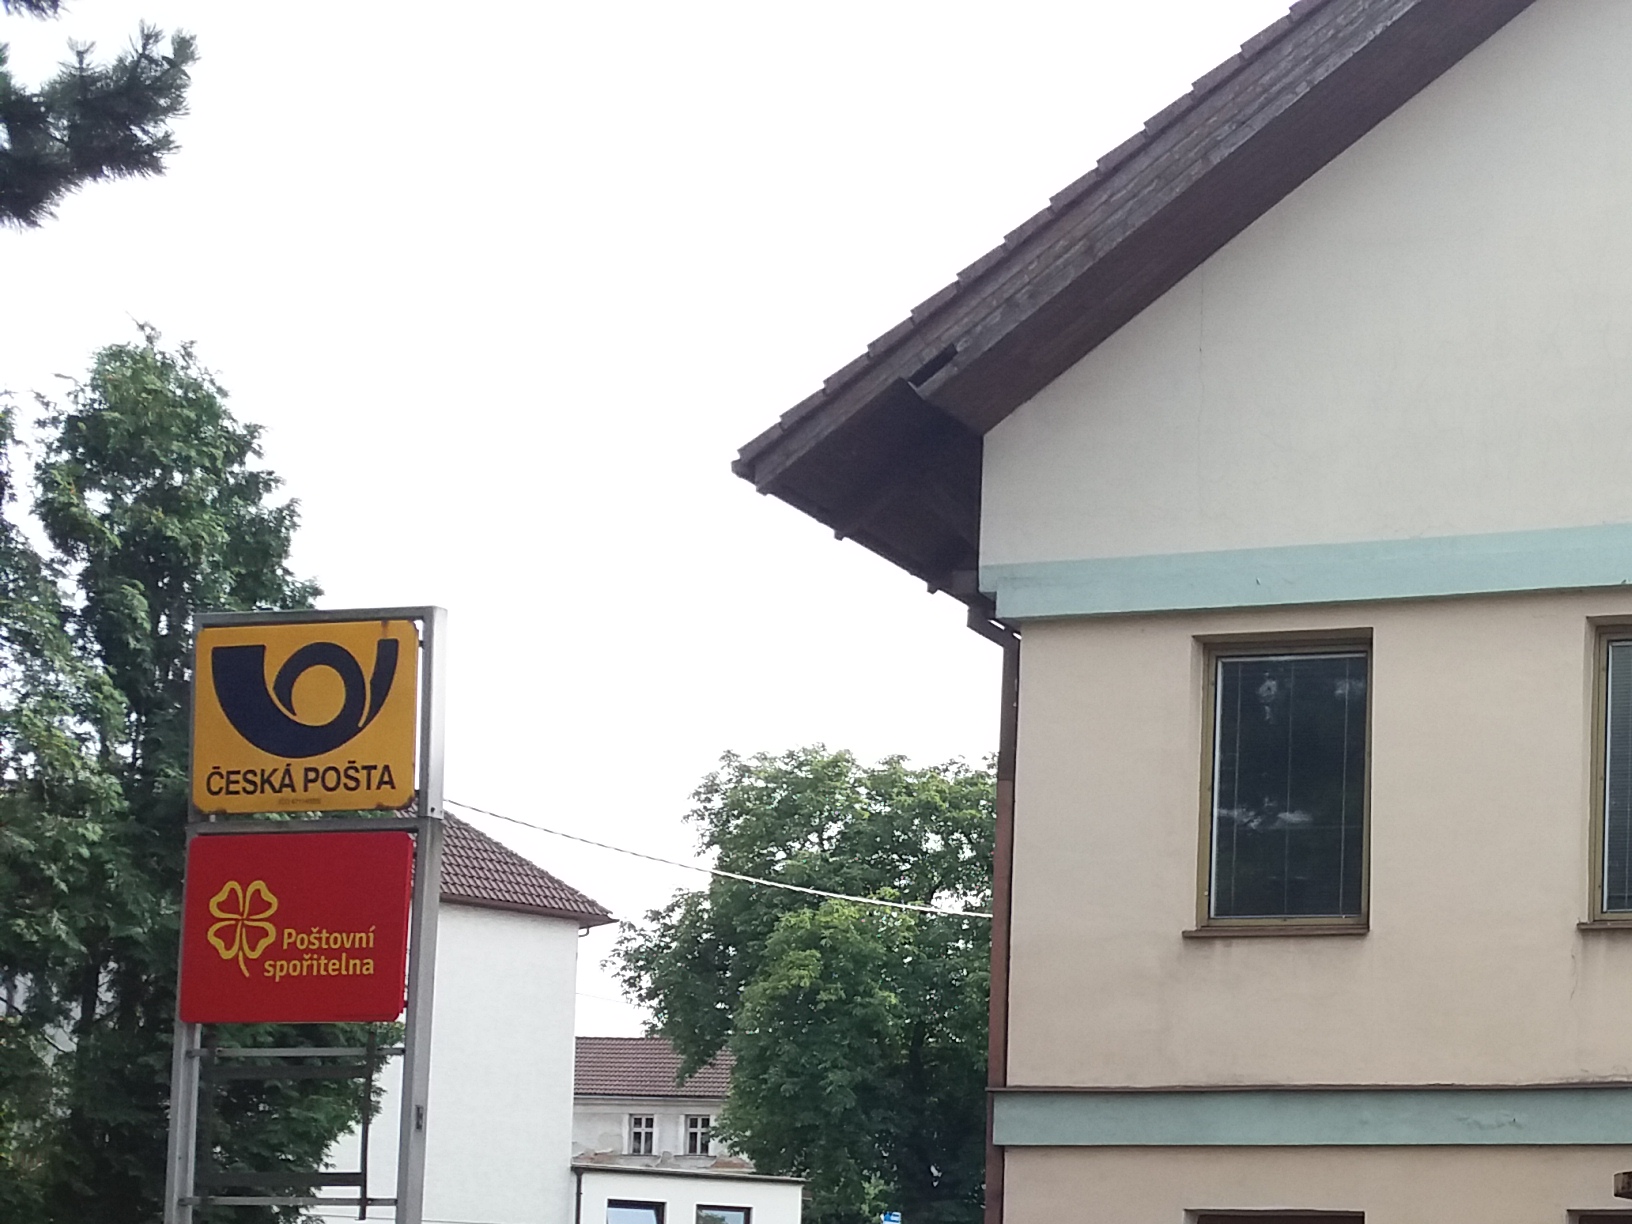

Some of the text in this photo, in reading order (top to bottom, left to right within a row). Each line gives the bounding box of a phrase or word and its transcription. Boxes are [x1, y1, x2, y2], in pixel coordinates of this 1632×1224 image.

[206, 760, 396, 796] ČESKÁ POŠTA
[283, 925, 375, 950] Poštovní
[264, 953, 375, 982] spořitelna
